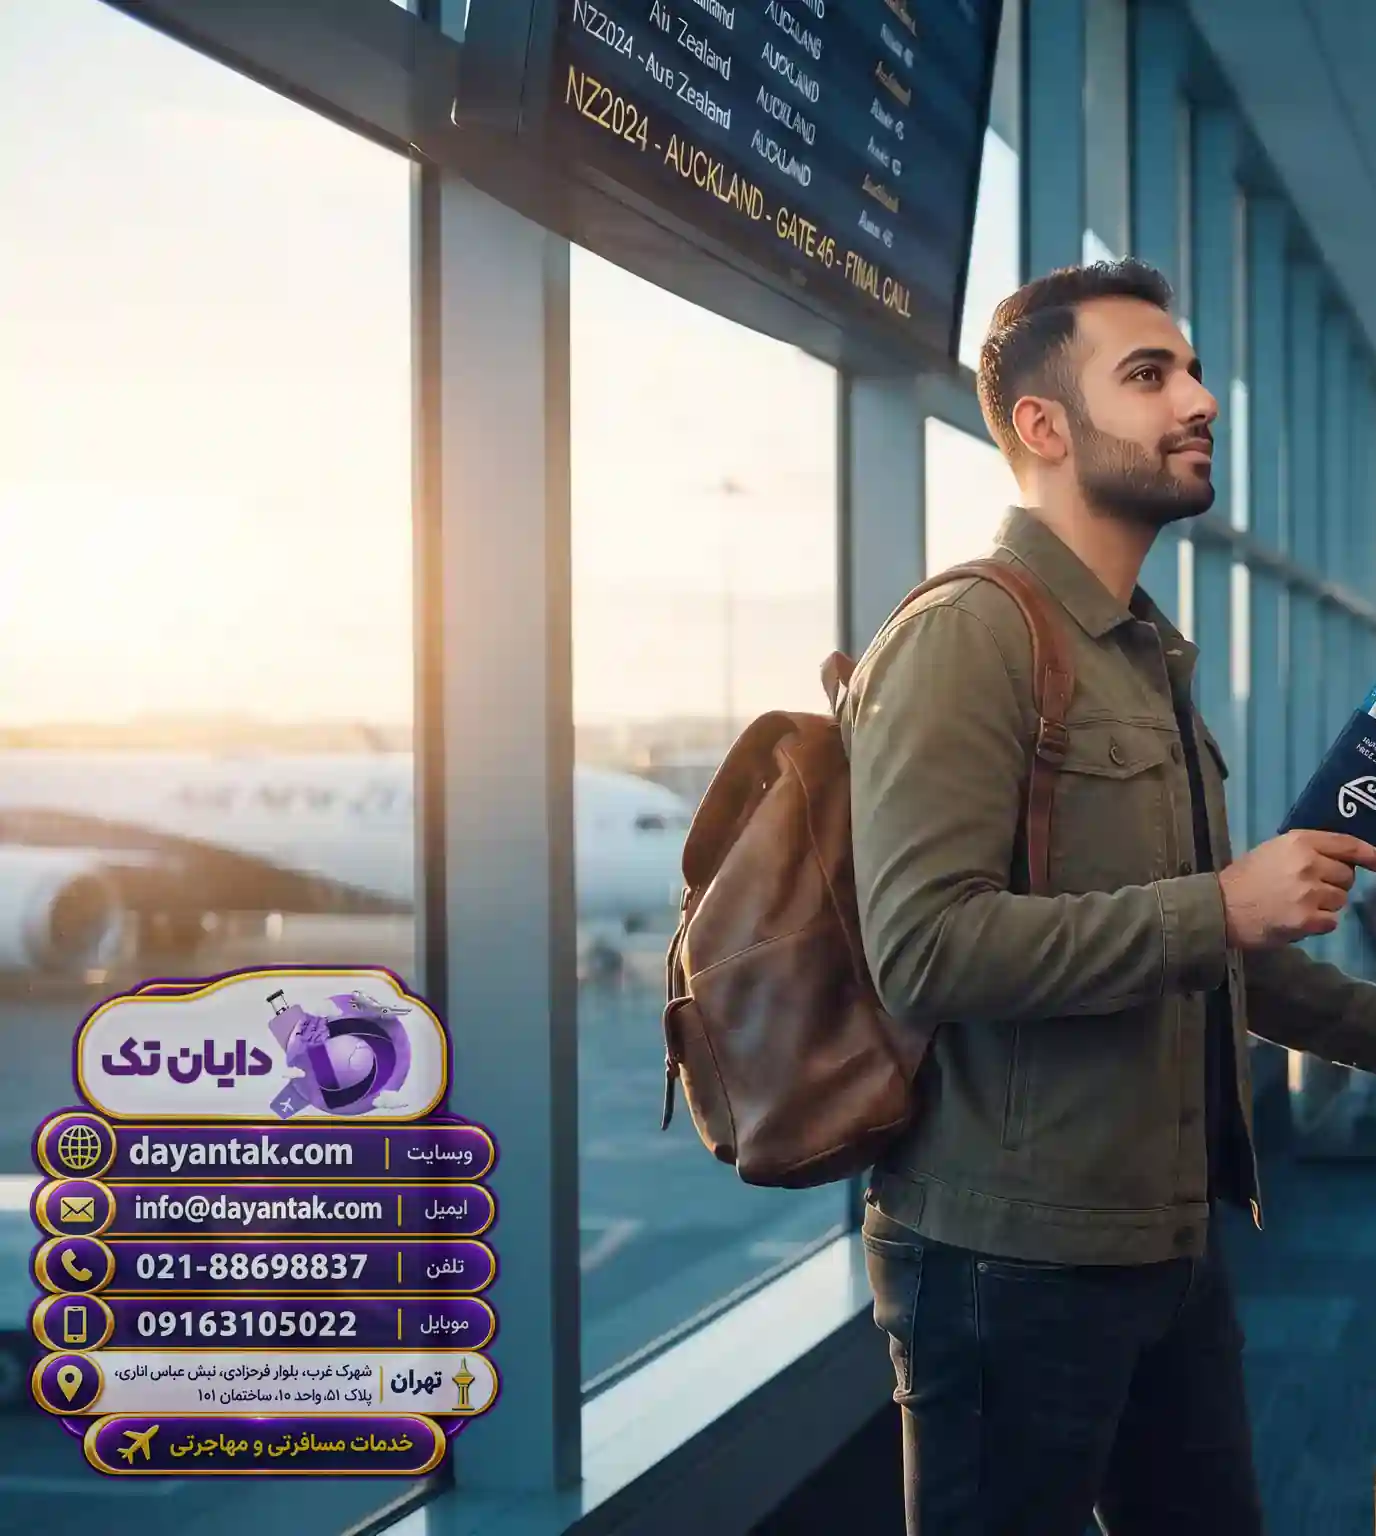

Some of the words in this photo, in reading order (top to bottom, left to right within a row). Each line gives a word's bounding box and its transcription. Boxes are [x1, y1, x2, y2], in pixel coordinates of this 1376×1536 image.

[573, 0, 633, 59] NZ2024
[676, 71, 732, 130] Zealand
[677, 17, 732, 81] Zealand
[565, 65, 649, 152] NZ2024
[664, 133, 764, 220] AUCKLAND
[776, 206, 817, 258] GATE
[816, 235, 836, 269] 46
[844, 250, 881, 300] FINAL
[882, 276, 912, 319] CALL
